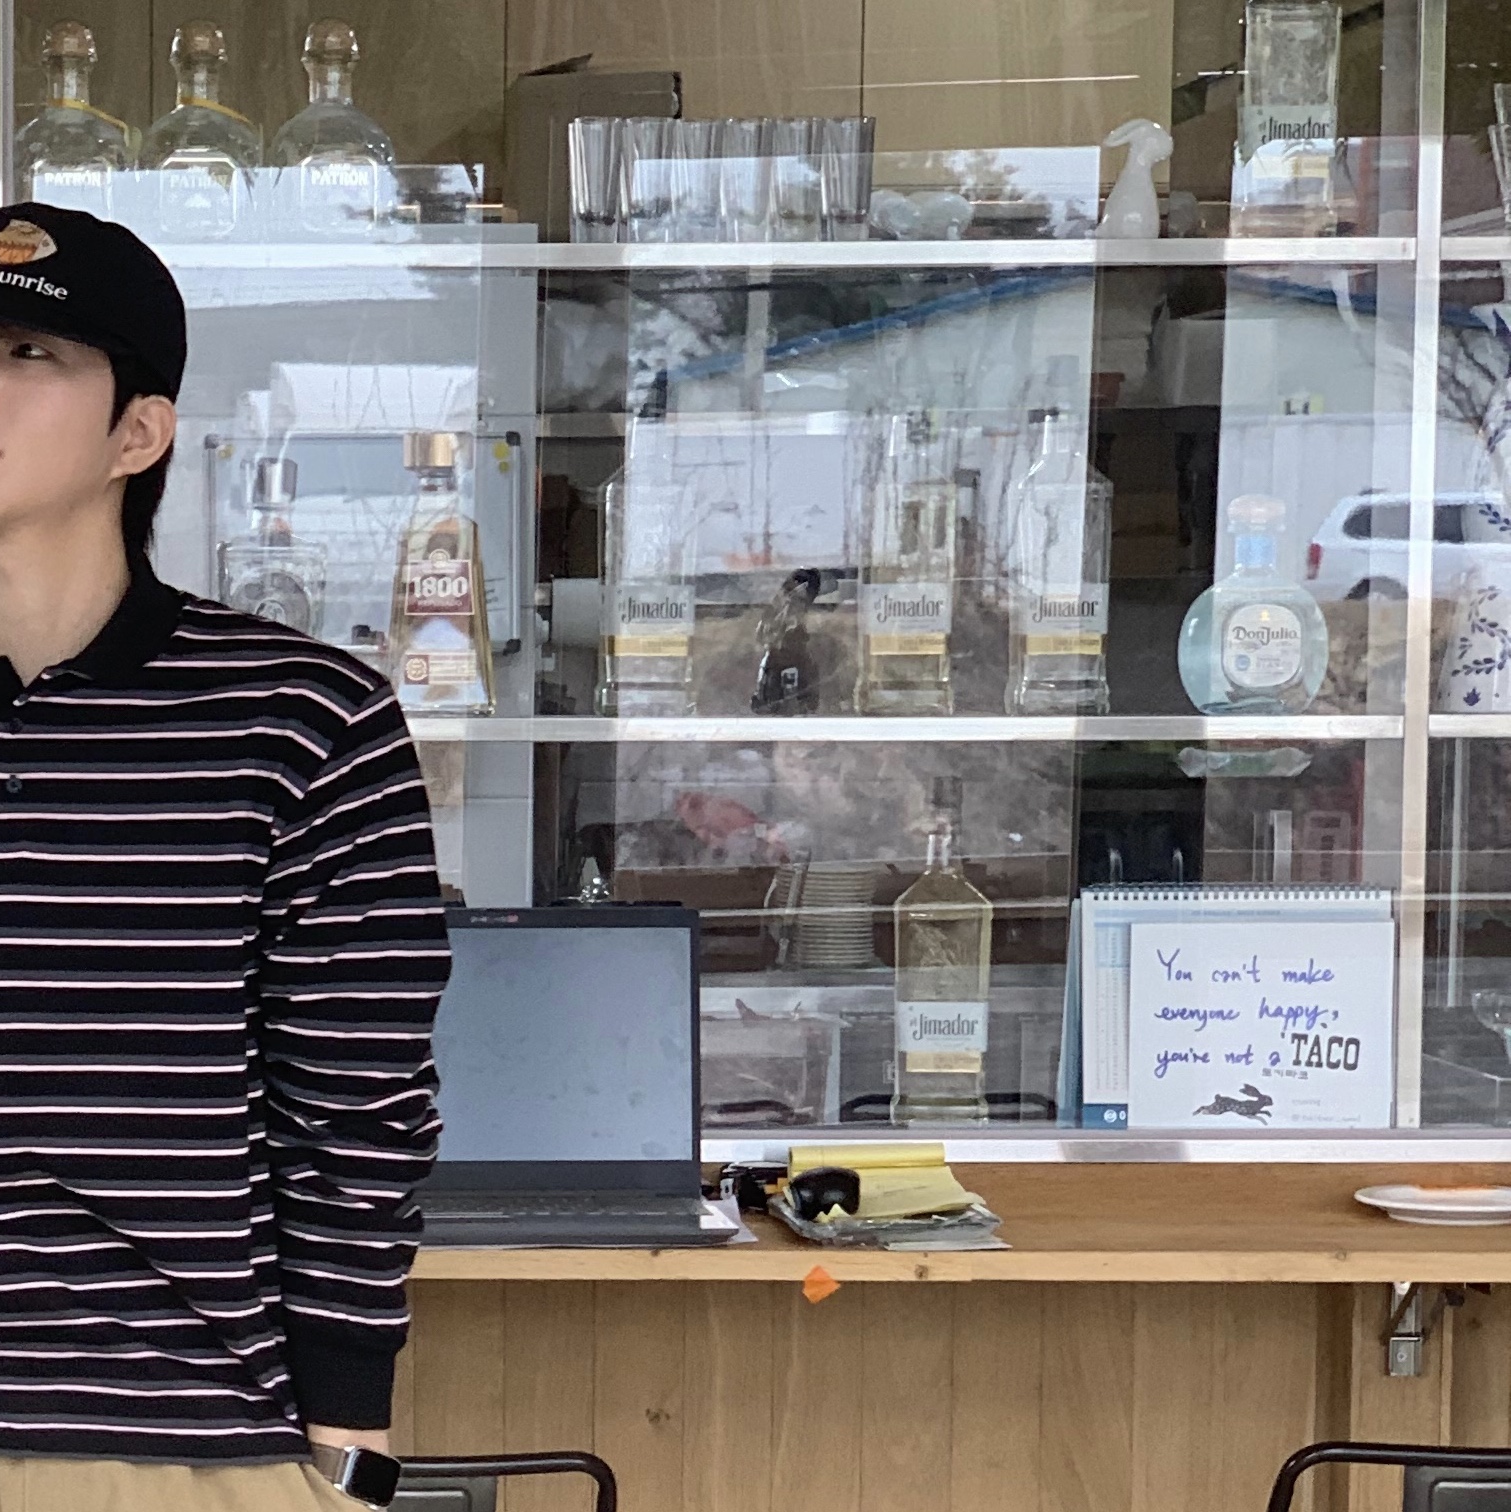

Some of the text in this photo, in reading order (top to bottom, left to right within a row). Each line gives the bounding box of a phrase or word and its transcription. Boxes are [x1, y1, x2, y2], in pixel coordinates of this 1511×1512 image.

[1261, 116, 1329, 144] Jimador
[411, 576, 468, 598] 1800
[621, 597, 687, 624] Jimador
[876, 594, 944, 623] Jimador
[1031, 595, 1099, 623] Jimador
[1157, 948, 1335, 985] You can't make
[912, 1013, 979, 1041] Jimador
[1154, 1006, 1240, 1032] everyone
[1154, 1032, 1361, 1079] you're not a TACO
